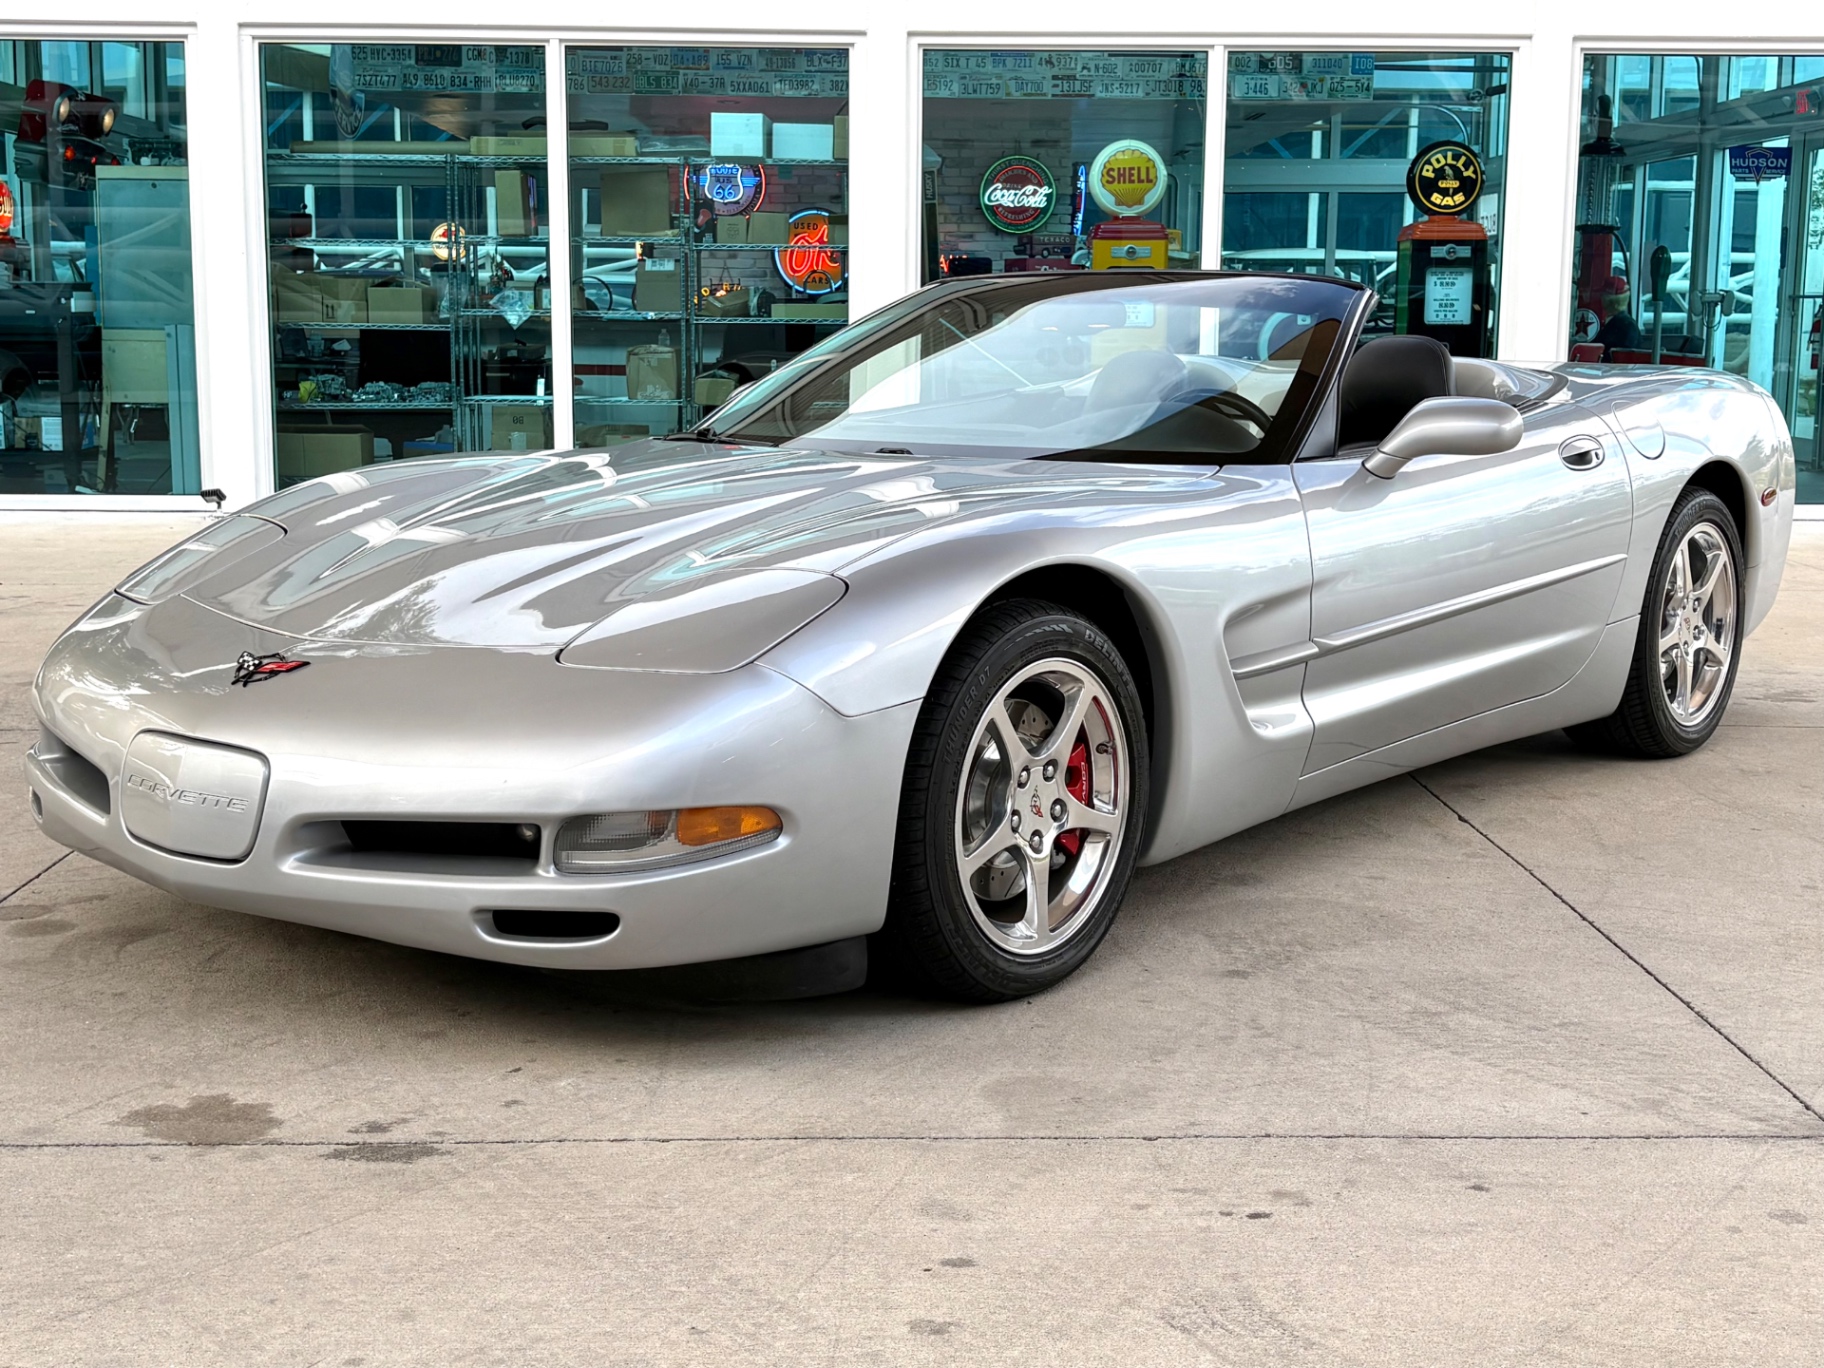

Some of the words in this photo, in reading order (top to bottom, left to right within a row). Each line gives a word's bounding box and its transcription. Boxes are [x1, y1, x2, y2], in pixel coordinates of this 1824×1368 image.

[1421, 151, 1477, 180] POLLY
[1731, 158, 1788, 168] HUDSON
[1105, 165, 1154, 185] SHELL
[713, 183, 736, 200] 66
[984, 182, 1053, 208] Coca-Cola
[1430, 191, 1466, 206] GAS
[793, 222, 819, 231] USED
[943, 686, 979, 764] THUNDER
[125, 772, 250, 814] CORVETTE
